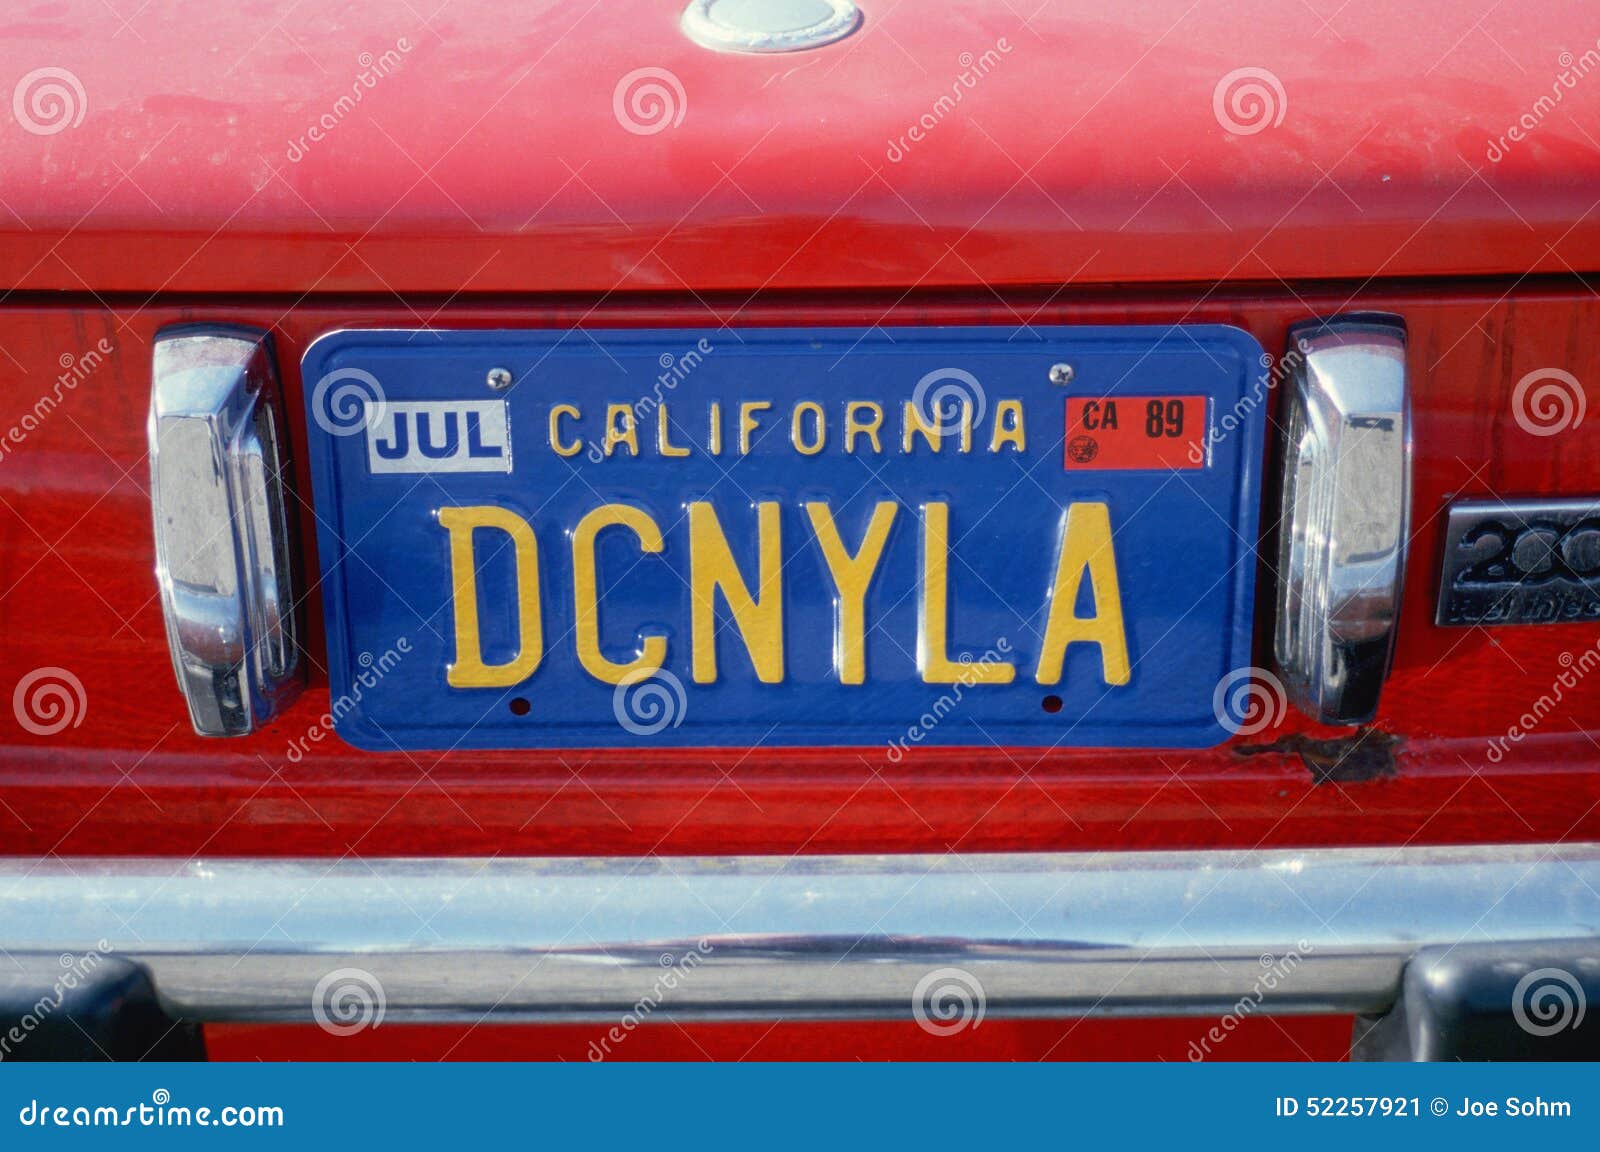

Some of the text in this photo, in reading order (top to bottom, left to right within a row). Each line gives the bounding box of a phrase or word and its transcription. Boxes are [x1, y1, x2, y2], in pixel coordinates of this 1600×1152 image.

[376, 413, 503, 460] JUL
[549, 399, 1026, 458] CALIFORNIA
[1082, 400, 1184, 438] CA 89
[437, 500, 1132, 688] DCNYLA
